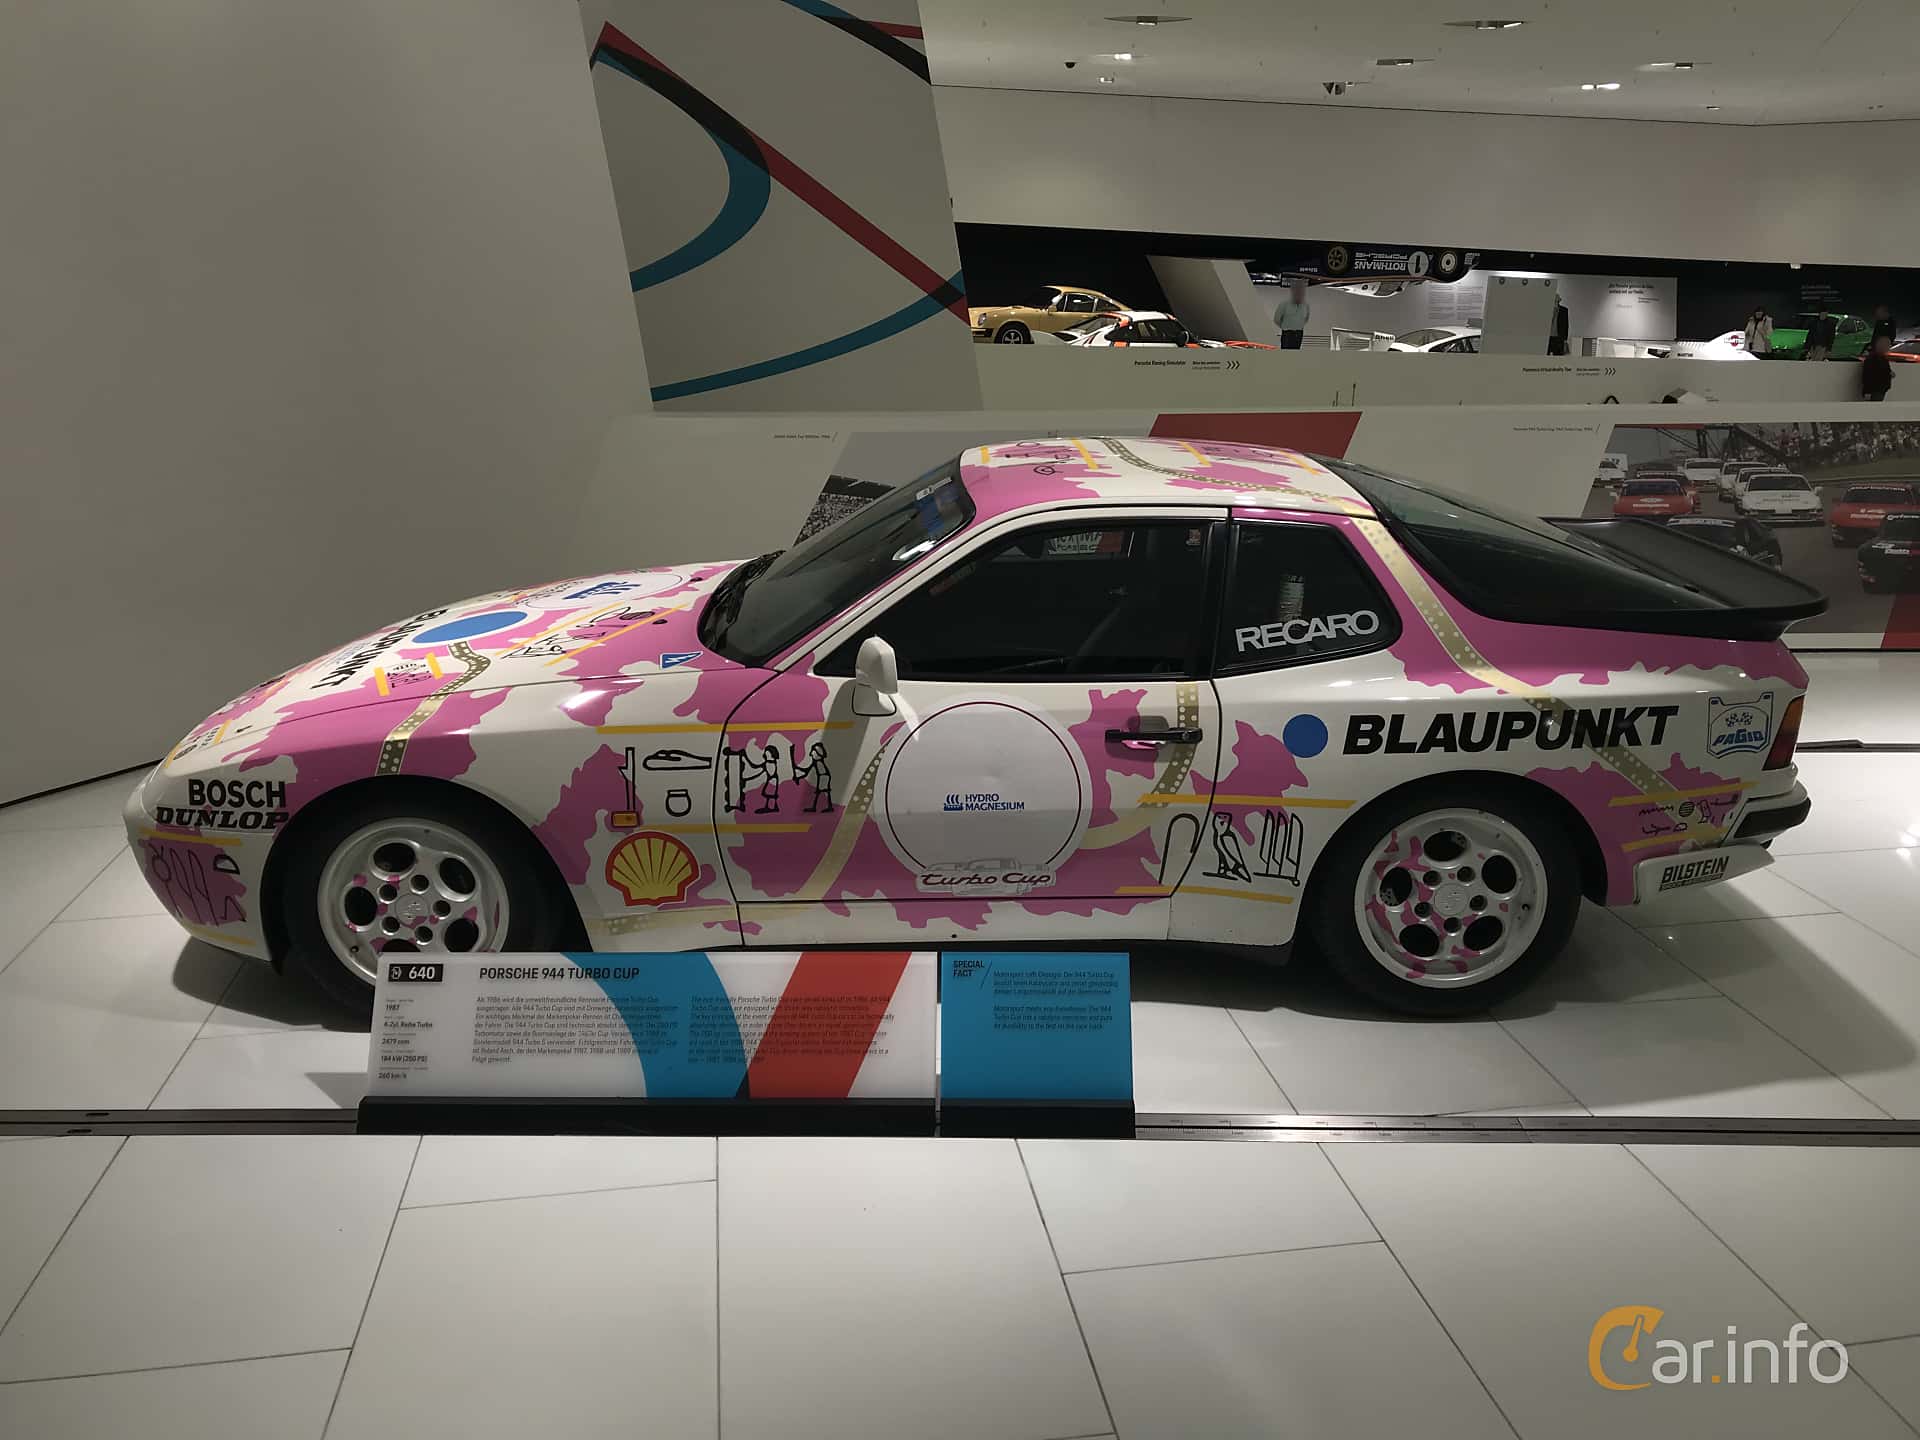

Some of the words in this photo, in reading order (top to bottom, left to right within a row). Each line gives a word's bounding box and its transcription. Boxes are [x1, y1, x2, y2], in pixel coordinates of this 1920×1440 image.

[1354, 260, 1407, 271] ROTHMANS
[1235, 610, 1380, 652] RECARO
[1343, 705, 1680, 755] BLAUPUNKT
[188, 779, 286, 808] BOSCH
[965, 794, 1000, 802] HYDRO
[965, 802, 1024, 811] MAGNESIUM
[156, 806, 289, 829] DUNLOP
[1662, 856, 1730, 884] BILSTEIN
[1001, 873, 1051, 886] Cup
[953, 960, 985, 968] SPECIAL
[408, 966, 435, 980] 640
[480, 967, 538, 980] PORSCHE
[541, 967, 565, 980] 944
[568, 967, 611, 980] TURBO
[613, 967, 640, 980] CUP
[953, 969, 973, 977] FACT
